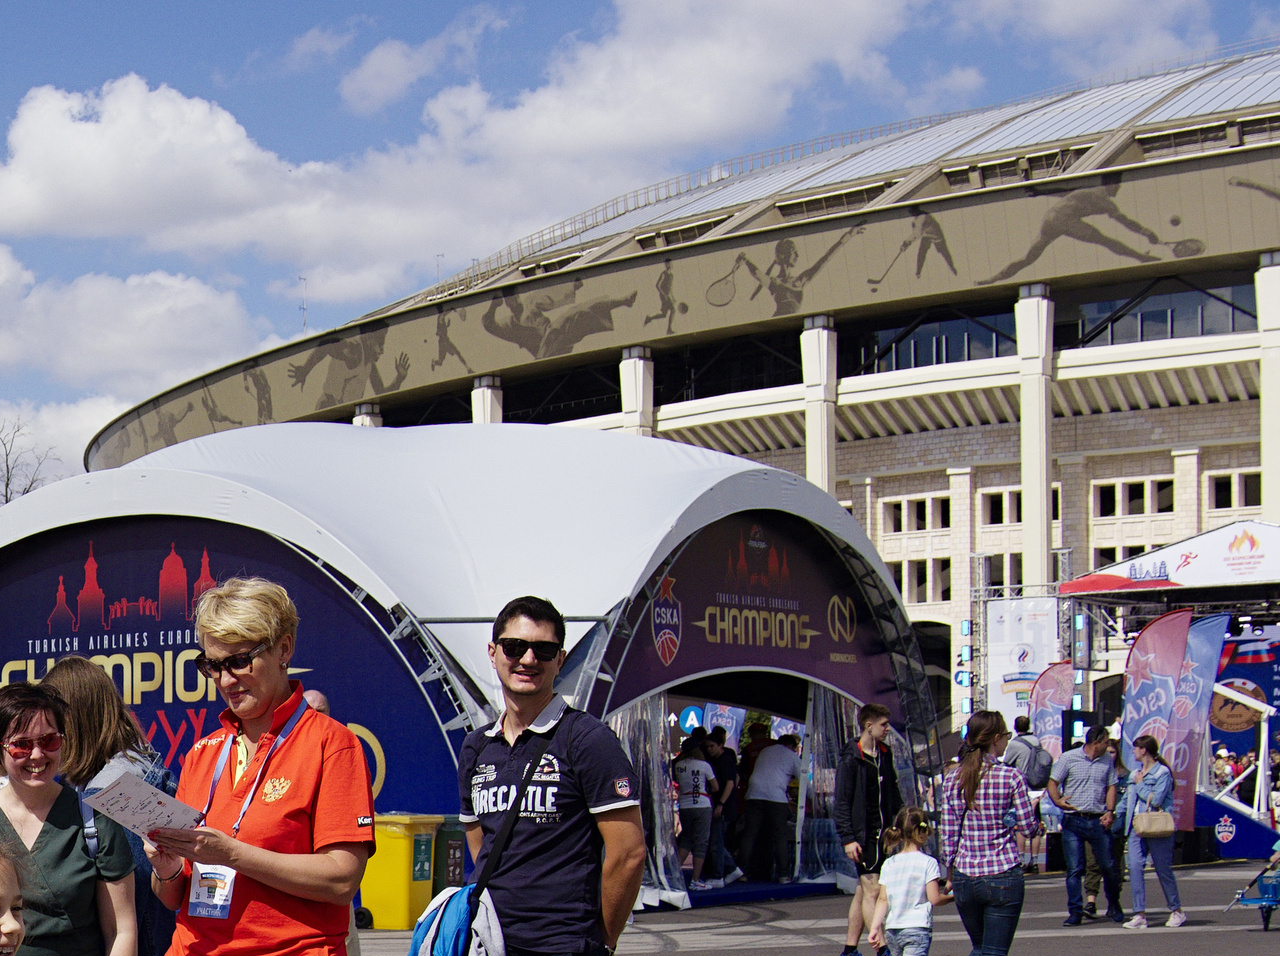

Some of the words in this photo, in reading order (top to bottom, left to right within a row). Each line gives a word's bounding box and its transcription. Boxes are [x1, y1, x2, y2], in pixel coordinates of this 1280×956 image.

[654, 606, 679, 625] CSKA
[693, 606, 820, 650] CHAMPIONS
[28, 637, 79, 654] TURKISH
[89, 632, 148, 650] AIRLINES
[685, 711, 700, 728] A
